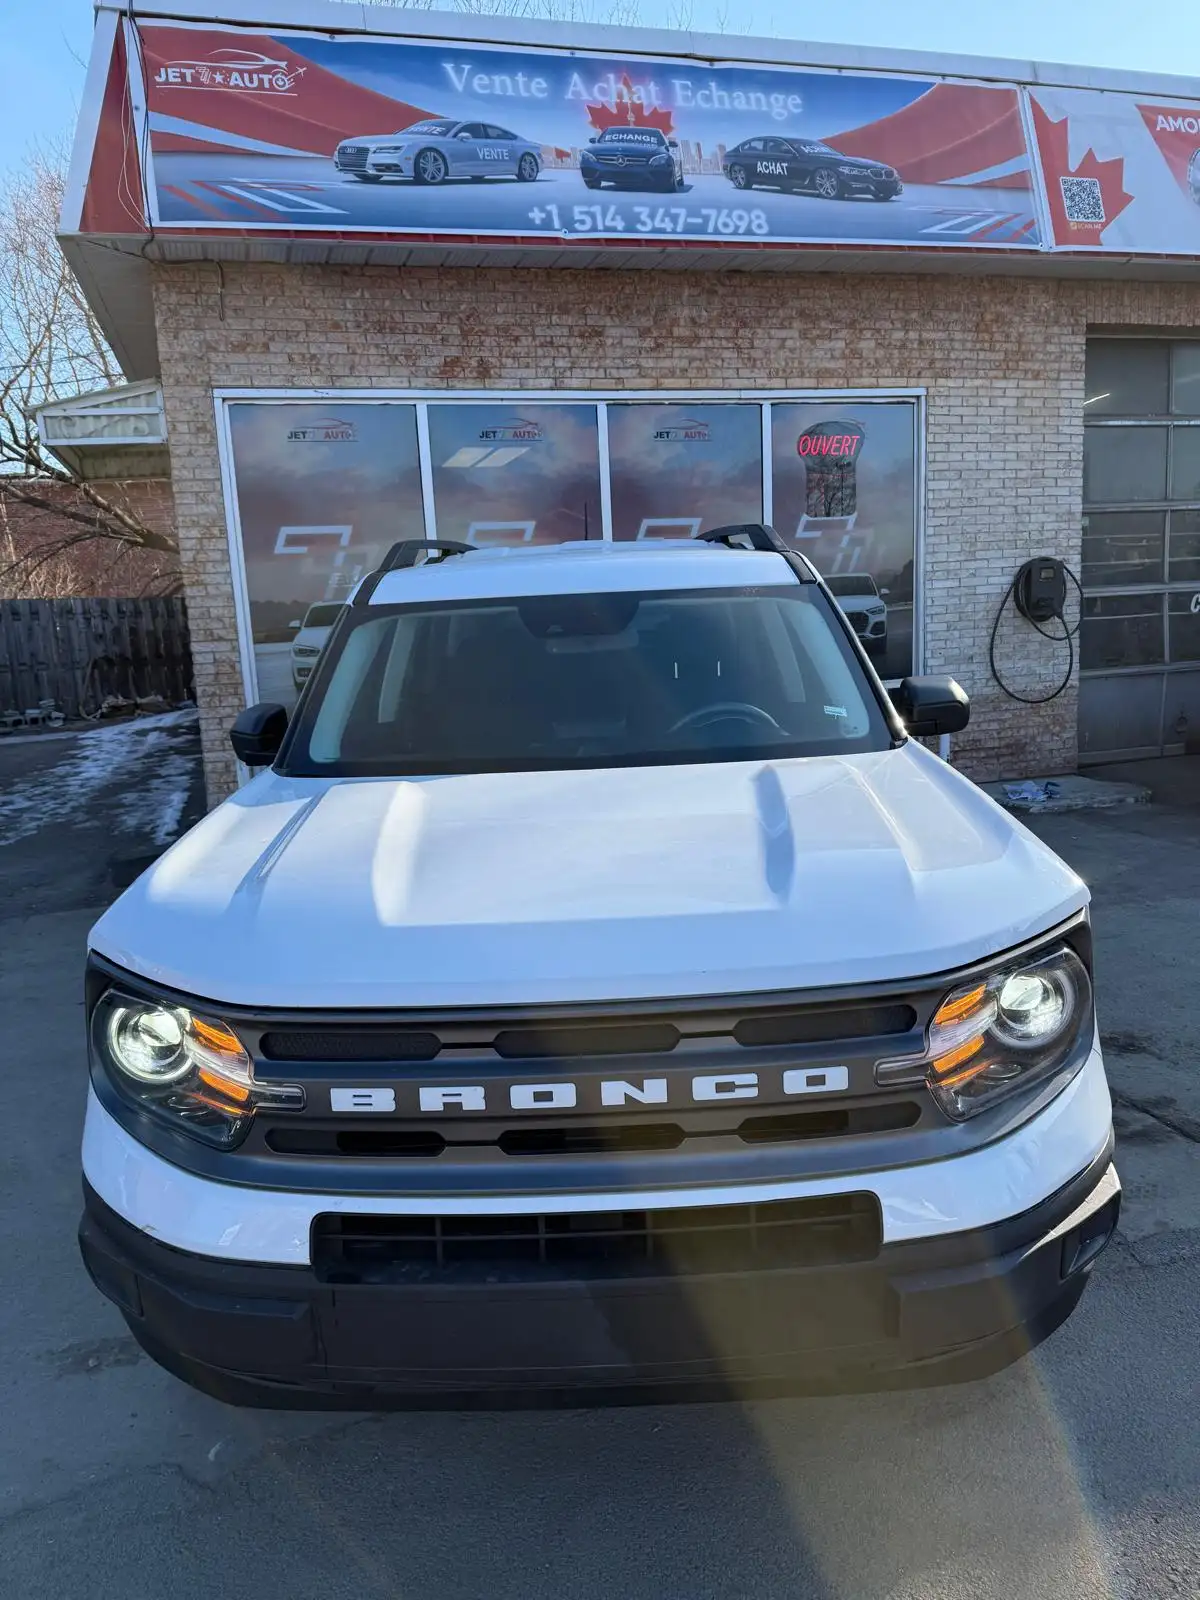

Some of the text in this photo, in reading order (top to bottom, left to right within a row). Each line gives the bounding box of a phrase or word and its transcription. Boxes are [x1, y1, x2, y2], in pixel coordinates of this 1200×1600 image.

[229, 71, 289, 91] AUTO
[441, 62, 804, 121] Vente Achat Echange
[1156, 114, 1200, 134] AMO
[605, 133, 658, 144] ECHANGE
[476, 147, 510, 160] VENTE
[757, 160, 788, 176] ACHAT
[528, 204, 770, 235] +1 514 347-7698
[799, 434, 860, 456] OUVERT
[330, 1066, 849, 1112] BRONCO
